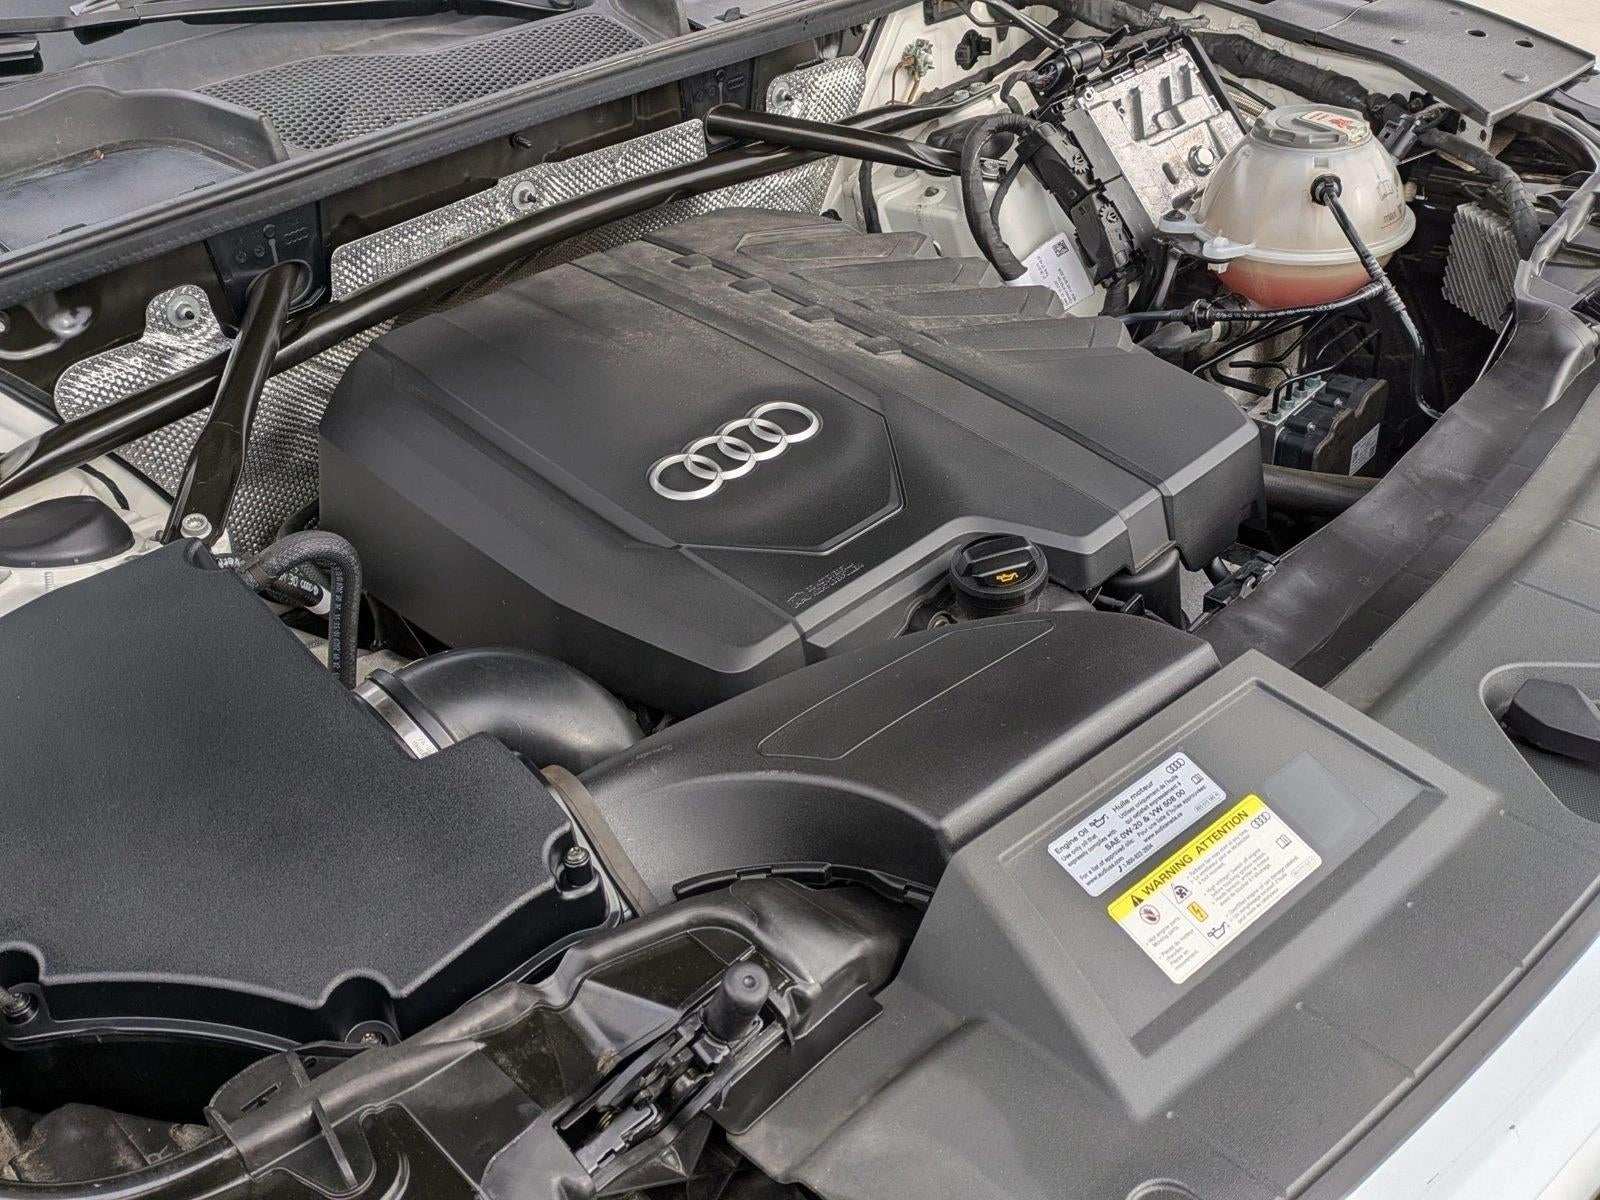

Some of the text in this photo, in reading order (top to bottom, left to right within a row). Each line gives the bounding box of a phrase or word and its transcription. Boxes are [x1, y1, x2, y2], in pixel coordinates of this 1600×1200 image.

[1111, 779, 1154, 813] Huile moteur
[1103, 836, 1121, 851] SAE
[1118, 819, 1143, 839] 0W-20
[1161, 795, 1177, 807] 508
[1053, 834, 1080, 855] Engine
[1086, 835, 1108, 852] complies
[1102, 844, 1126, 863] approved
[1141, 808, 1249, 897] WARNING ATTENTION
